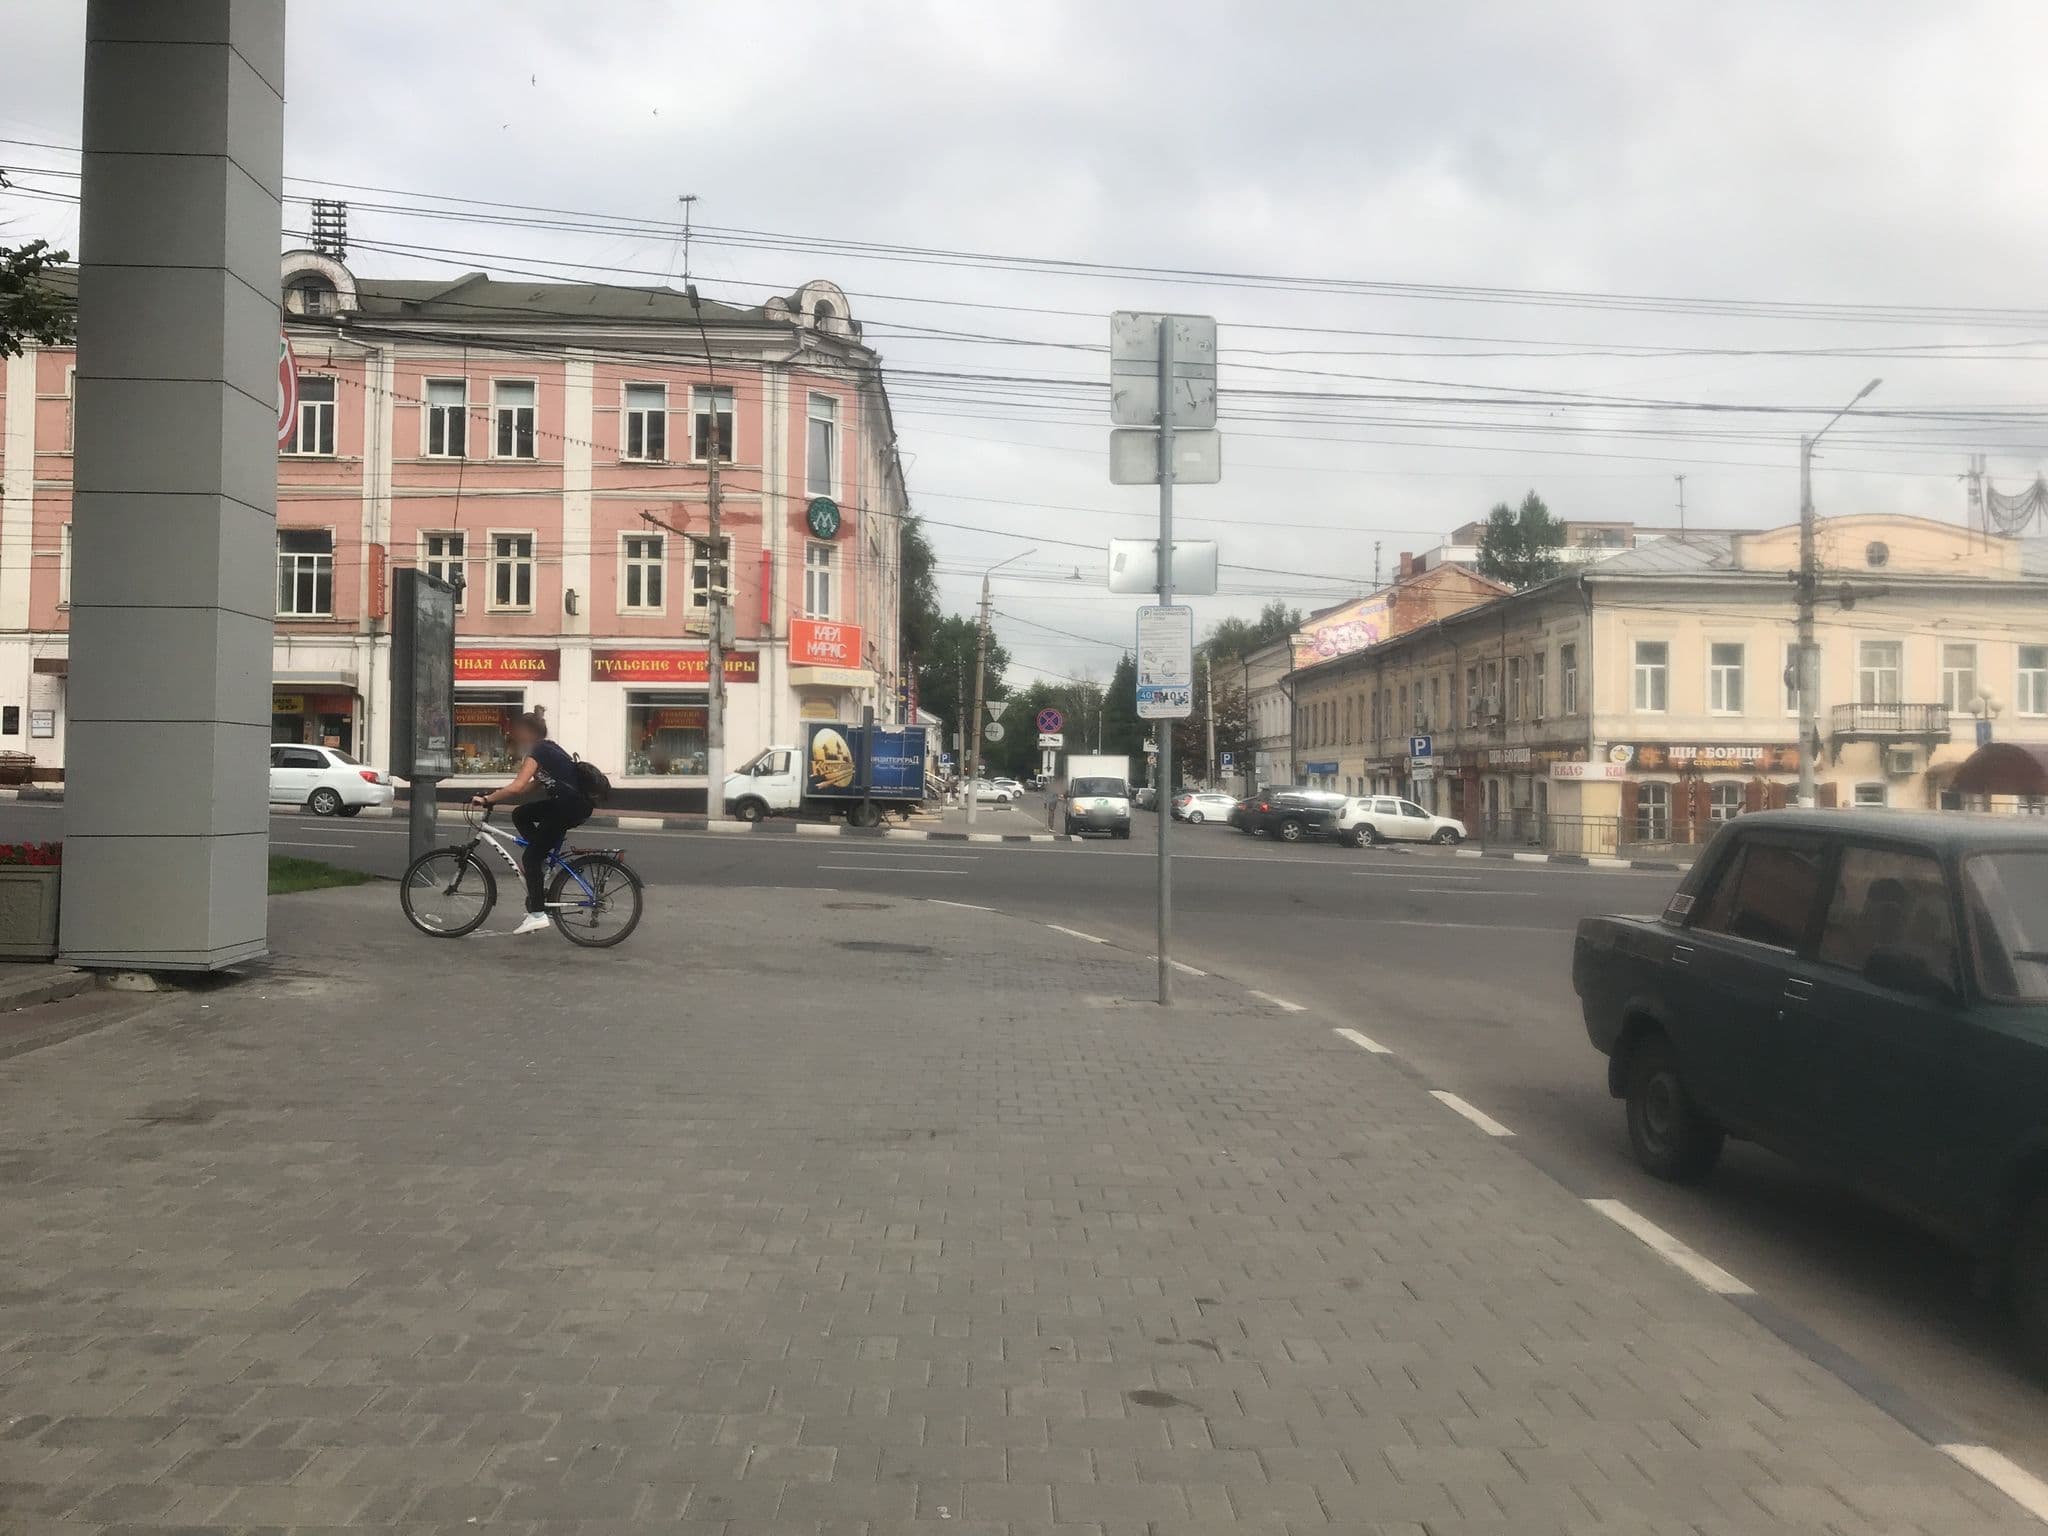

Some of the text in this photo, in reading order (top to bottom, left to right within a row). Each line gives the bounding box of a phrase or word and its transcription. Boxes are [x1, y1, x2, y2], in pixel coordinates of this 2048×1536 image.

[814, 624, 841, 642] КАРЛ
[807, 640, 848, 659] МАРКС
[500, 658, 546, 671] ЛАВКА
[594, 658, 756, 673] ТУЛЬСКИЕ СУВИРЫ
[1669, 746, 1763, 760] ЩИ БОРЩИ
[1553, 764, 1584, 777] КВАС
